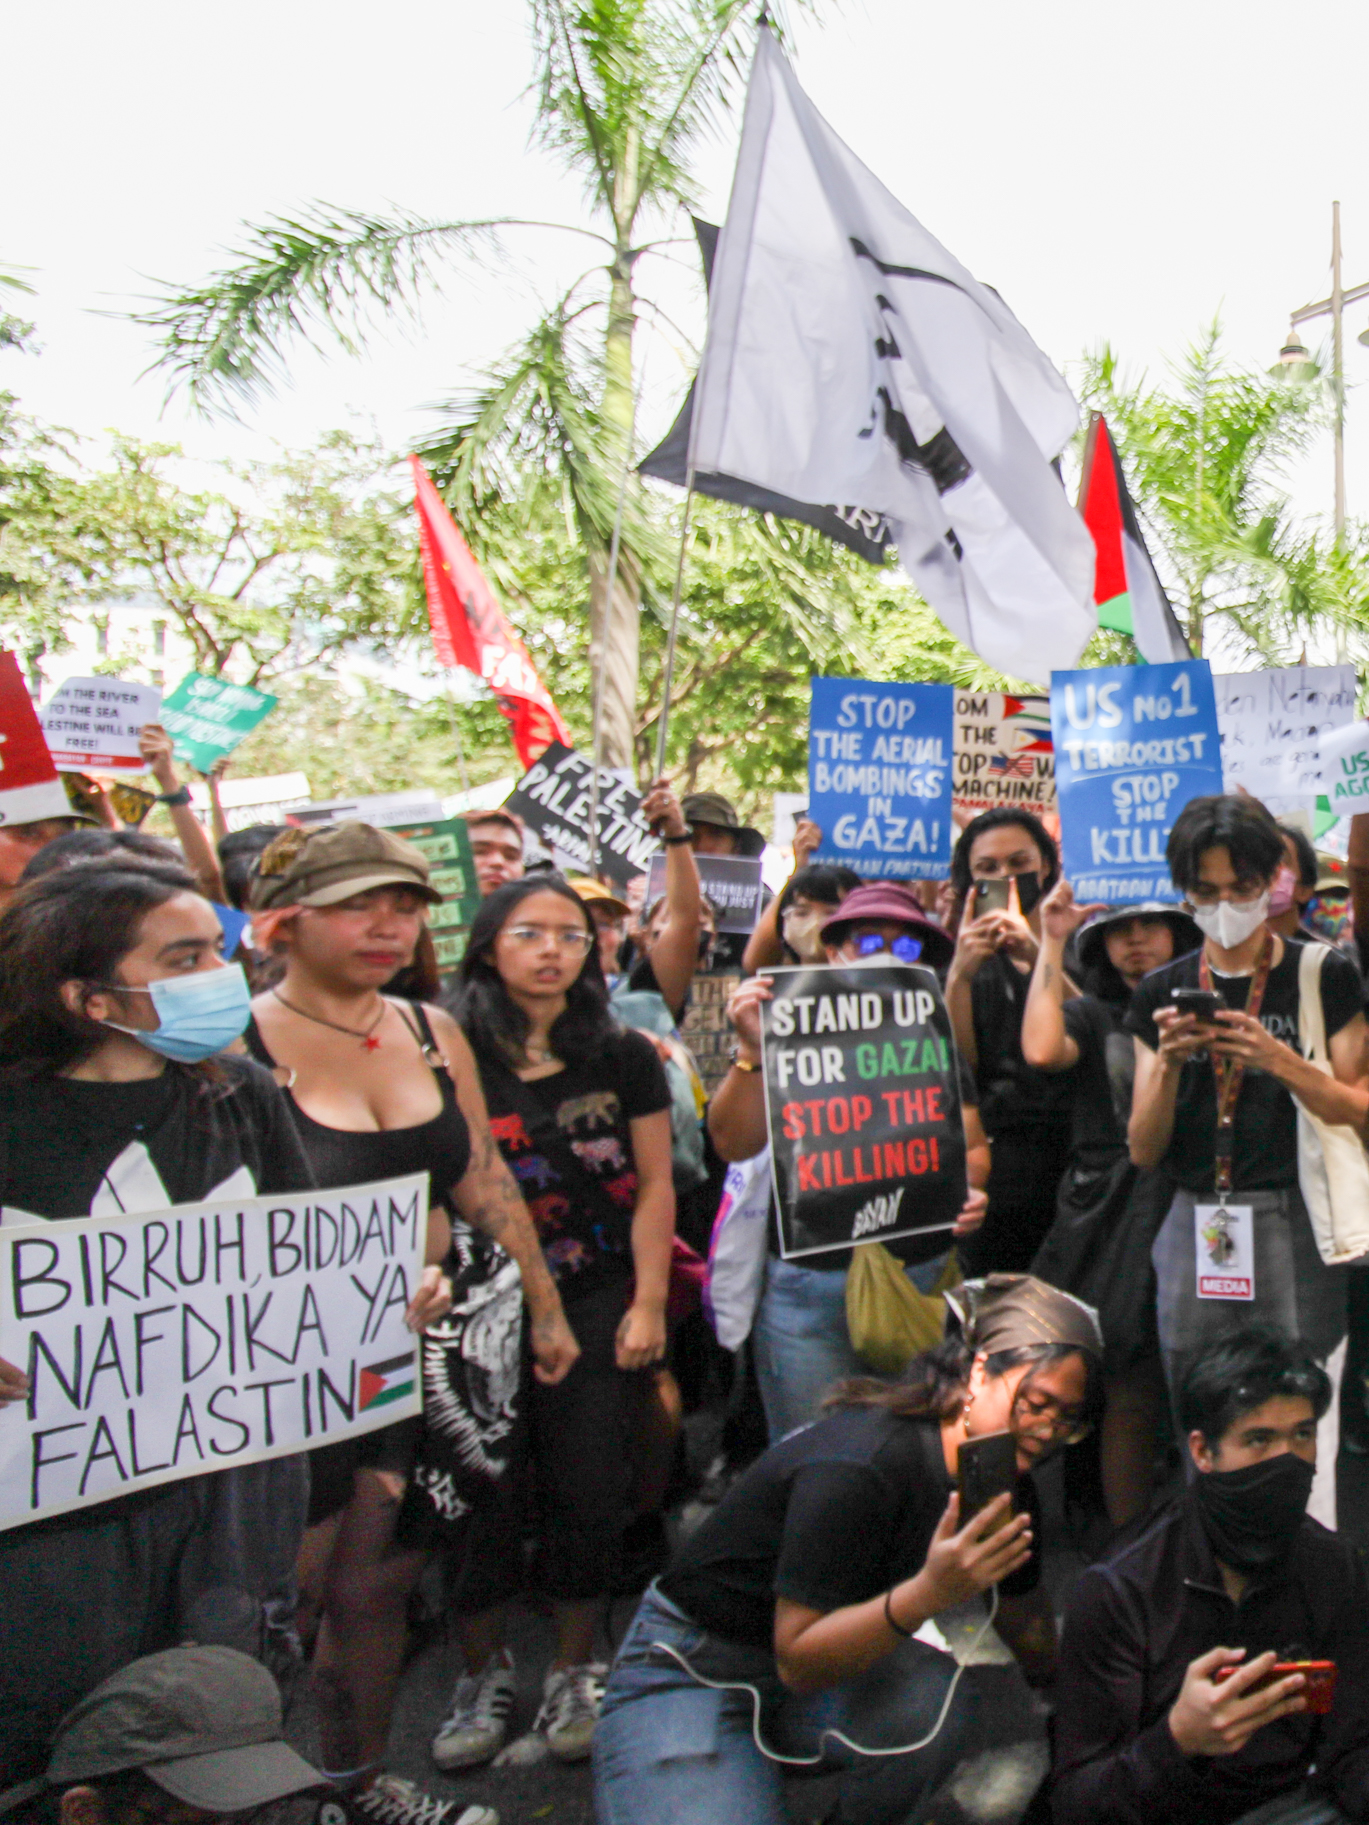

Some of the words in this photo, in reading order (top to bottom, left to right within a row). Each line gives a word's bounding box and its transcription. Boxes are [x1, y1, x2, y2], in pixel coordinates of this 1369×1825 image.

[95, 706, 120, 719] SEA
[98, 689, 139, 704] RIVER
[836, 694, 916, 730] STOP
[1063, 681, 1124, 730] US
[812, 730, 863, 761] THE
[871, 734, 949, 767] AERIAL
[960, 725, 997, 745] THE
[1061, 732, 1207, 771] TERRORIST
[814, 760, 945, 799] BOMBINGS
[1111, 771, 1180, 809] STOP
[867, 797, 892, 819] IN
[1115, 801, 1167, 826] THE
[832, 813, 940, 854] GAZA!
[1090, 826, 1171, 866] KILL
[770, 992, 883, 1036] STAND
[893, 990, 935, 1027] UP
[776, 1046, 846, 1088] FOR
[856, 1036, 949, 1080] GAZA!
[782, 1095, 873, 1141] STOP
[881, 1086, 946, 1127] THE
[797, 1137, 940, 1192] KILLING!
[267, 1190, 418, 1278] BIDDAM
[12, 1211, 261, 1321] BIRRUH,
[1202, 1278, 1248, 1294] MEDIA
[26, 1283, 329, 1421] NAFDIKA
[350, 1263, 411, 1346] YA
[30, 1358, 356, 1509] FALASTIN
